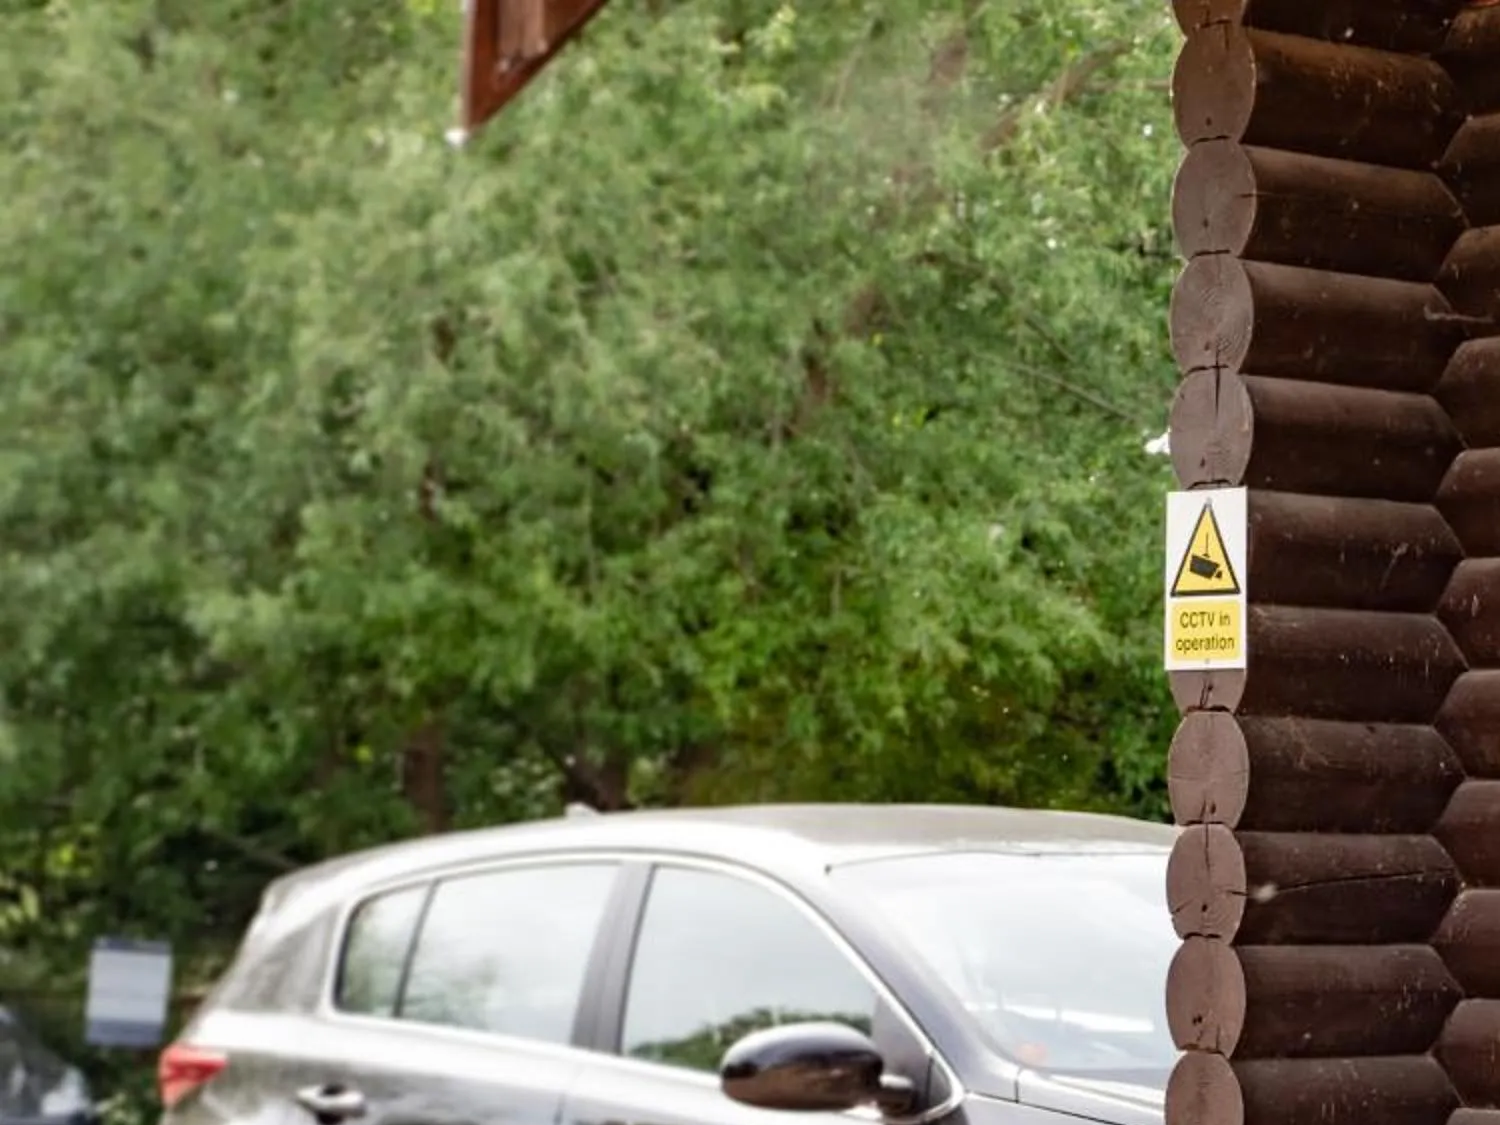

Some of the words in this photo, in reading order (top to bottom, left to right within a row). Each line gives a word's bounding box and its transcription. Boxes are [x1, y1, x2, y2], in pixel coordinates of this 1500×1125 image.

[1180, 612, 1215, 628] CCTV
[1219, 611, 1231, 626] in
[1176, 635, 1235, 655] operation
